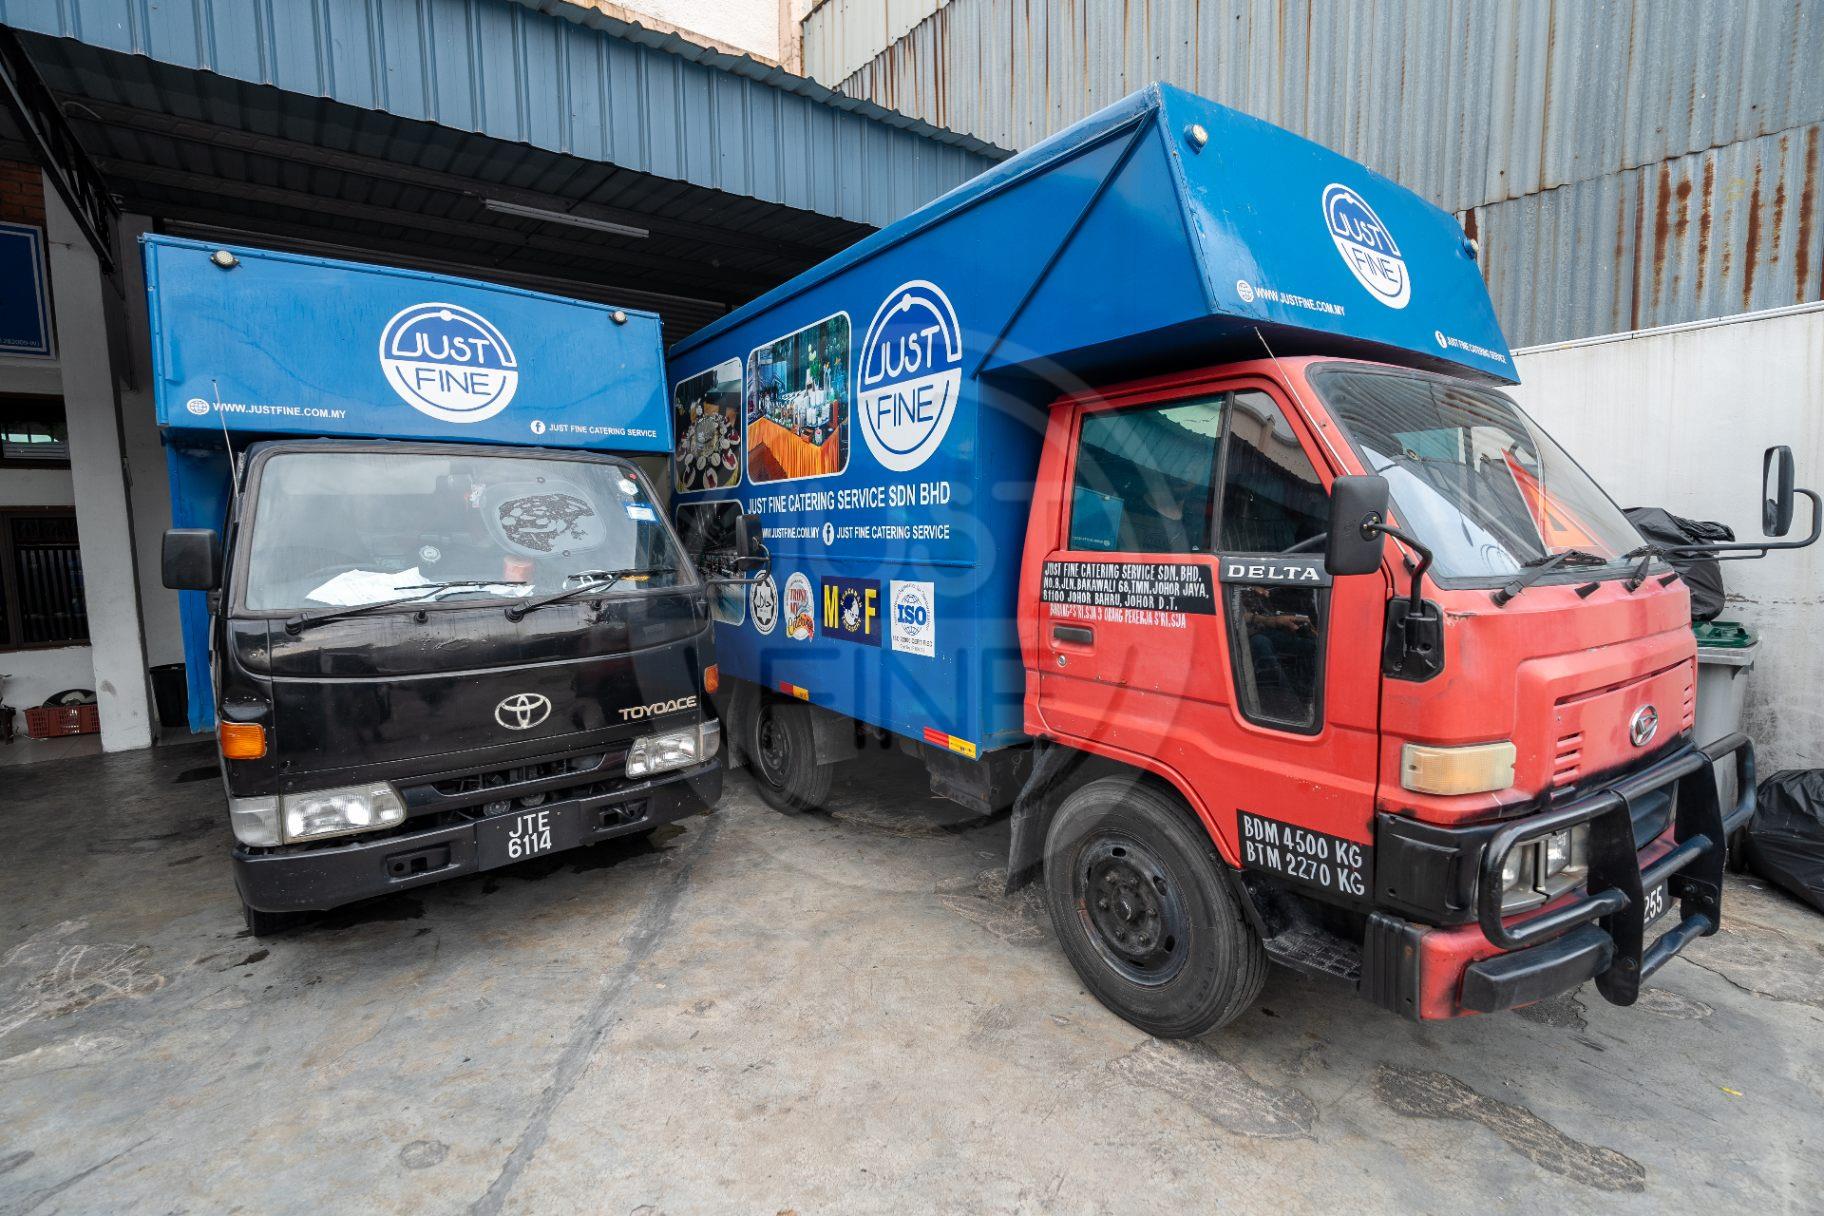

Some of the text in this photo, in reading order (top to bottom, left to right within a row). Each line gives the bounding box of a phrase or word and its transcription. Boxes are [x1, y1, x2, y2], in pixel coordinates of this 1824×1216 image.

[1334, 211, 1384, 251] JUST
[1351, 247, 1399, 284] FINE
[391, 332, 490, 364] JUST
[865, 325, 940, 385] JUST
[415, 367, 492, 396] FINE
[213, 402, 346, 419] WWW.JUSTFINE.COM.MY
[877, 385, 934, 430] FINE
[549, 424, 657, 438] JUST FINE CATERING SERVICE
[747, 481, 950, 515] JUST FINE CATERING SERVICE SDN BHD
[837, 524, 950, 539] JUST FINE CATERING SERVICE
[1045, 563, 1202, 582] JUST FINE CATERING SERVICE SDN. BHD.
[1227, 565, 1320, 581] DELTA
[1043, 590, 1065, 602] 81100
[1068, 591, 1092, 604] JOHOR
[1095, 592, 1123, 607] BAHRU,
[1125, 595, 1155, 609] JOHOR
[1182, 582, 1209, 599] JAYA,
[897, 603, 927, 626] ISO
[618, 695, 697, 721] TOYOACE
[508, 810, 551, 838] JTE
[508, 829, 552, 859] 6114
[1243, 815, 1363, 868] BDM 4500 KG
[1246, 841, 1365, 896] BTM 2270 KG
